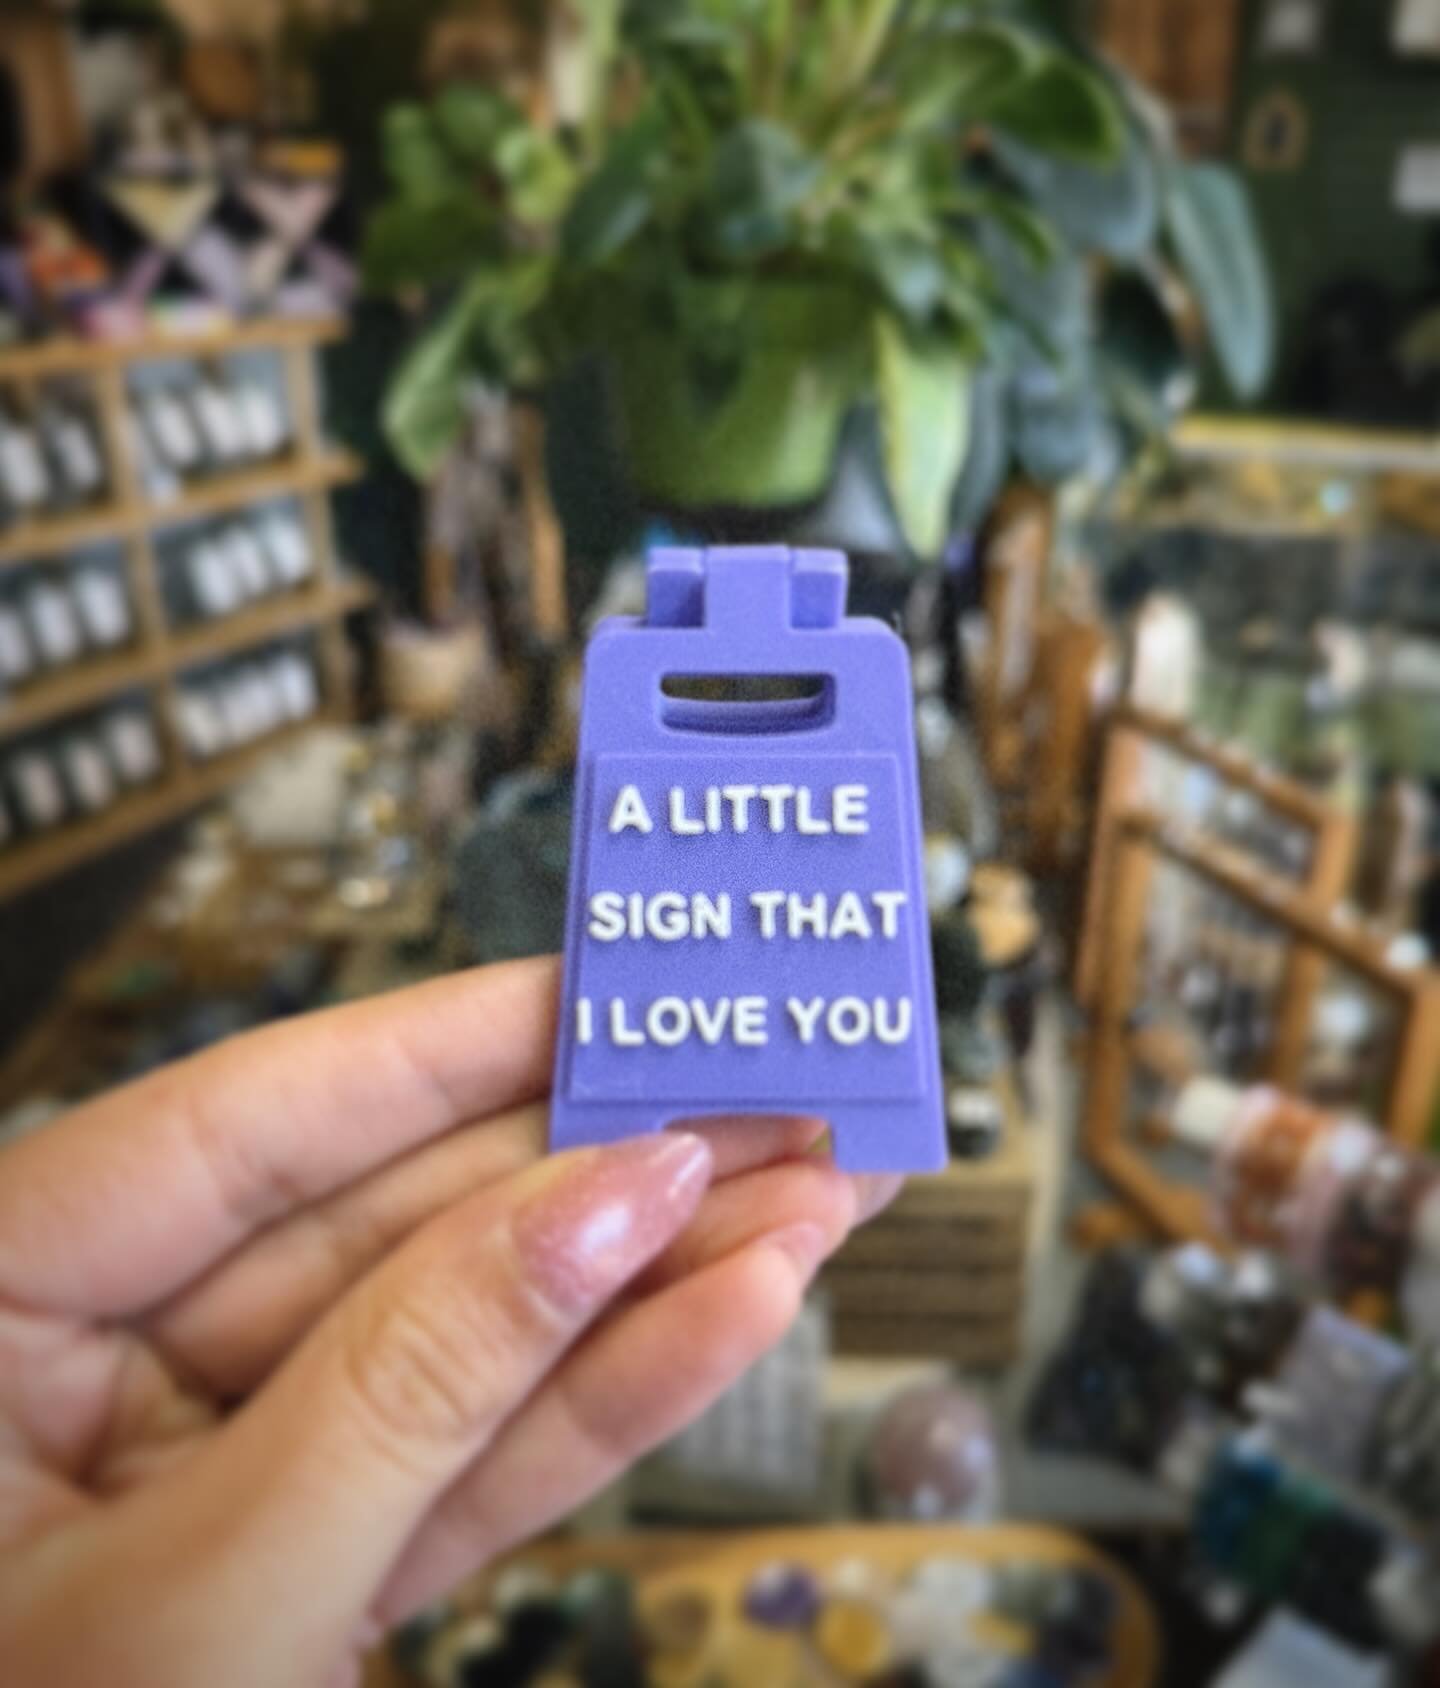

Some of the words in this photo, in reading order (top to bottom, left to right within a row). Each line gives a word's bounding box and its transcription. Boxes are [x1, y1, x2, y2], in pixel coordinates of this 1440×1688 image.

[608, 784, 653, 834] A
[669, 784, 869, 835] LITTLE
[588, 891, 732, 941] SIGN
[749, 891, 906, 940] THAT
[576, 997, 593, 1045] I
[610, 996, 768, 1046] LOVE
[786, 996, 912, 1045] YOU
